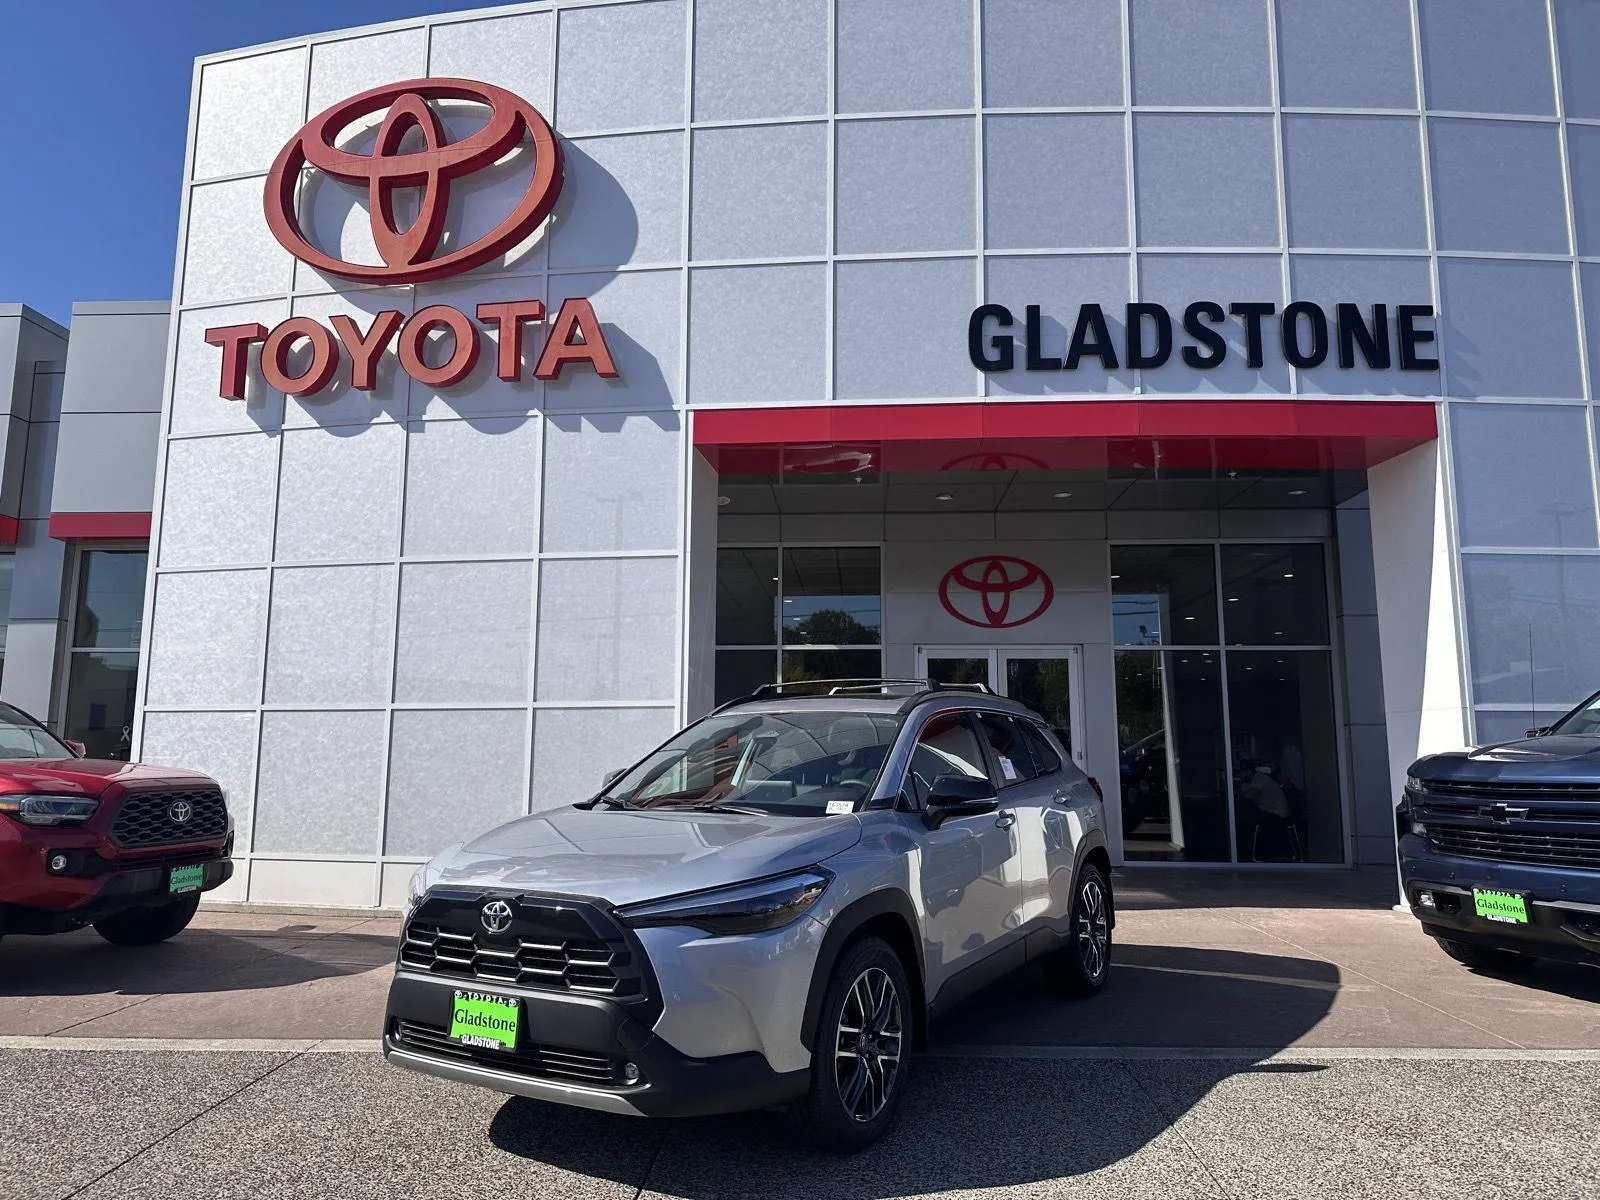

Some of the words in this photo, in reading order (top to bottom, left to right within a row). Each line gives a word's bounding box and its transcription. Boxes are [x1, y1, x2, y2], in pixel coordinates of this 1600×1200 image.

[968, 301, 1440, 371] GLADSTONE
[204, 297, 620, 401] TOYOTA
[1477, 898, 1525, 914] Gladstone
[467, 992, 503, 1003] TOYOTA
[454, 1008, 516, 1032] Gladstone
[461, 1034, 501, 1050] GLADSTONE
